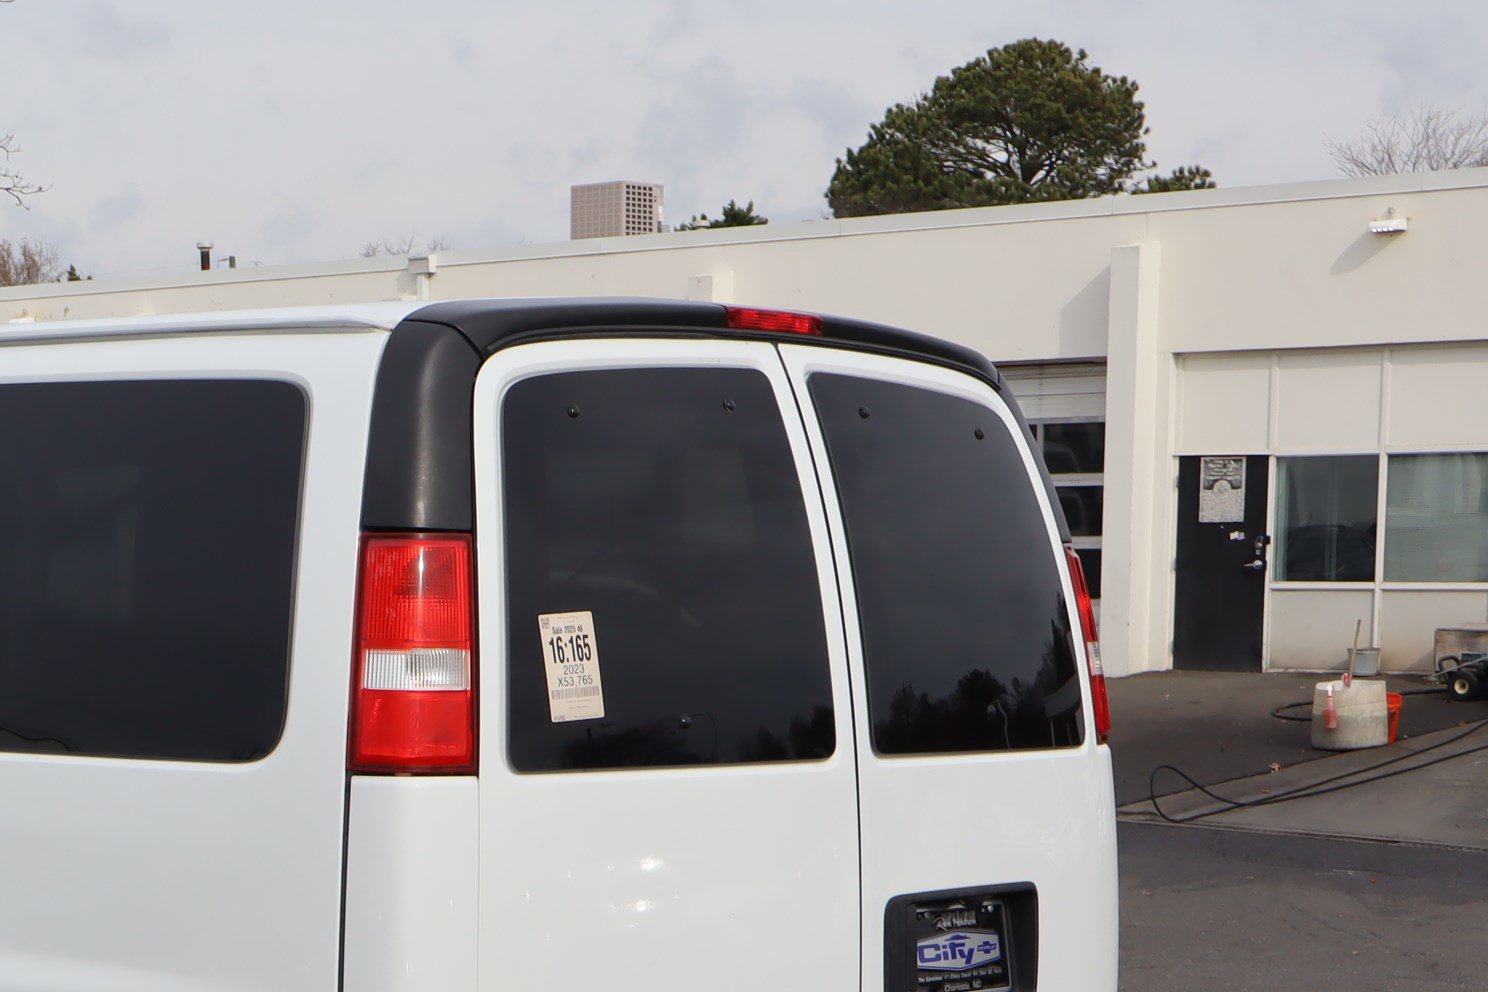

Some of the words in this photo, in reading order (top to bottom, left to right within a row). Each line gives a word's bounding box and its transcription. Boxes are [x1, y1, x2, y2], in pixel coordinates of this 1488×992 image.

[552, 627, 563, 635] Sale
[549, 634, 592, 664] 16:165
[563, 664, 585, 675] 2023
[557, 674, 593, 688] X53,765
[917, 941, 975, 965] City
